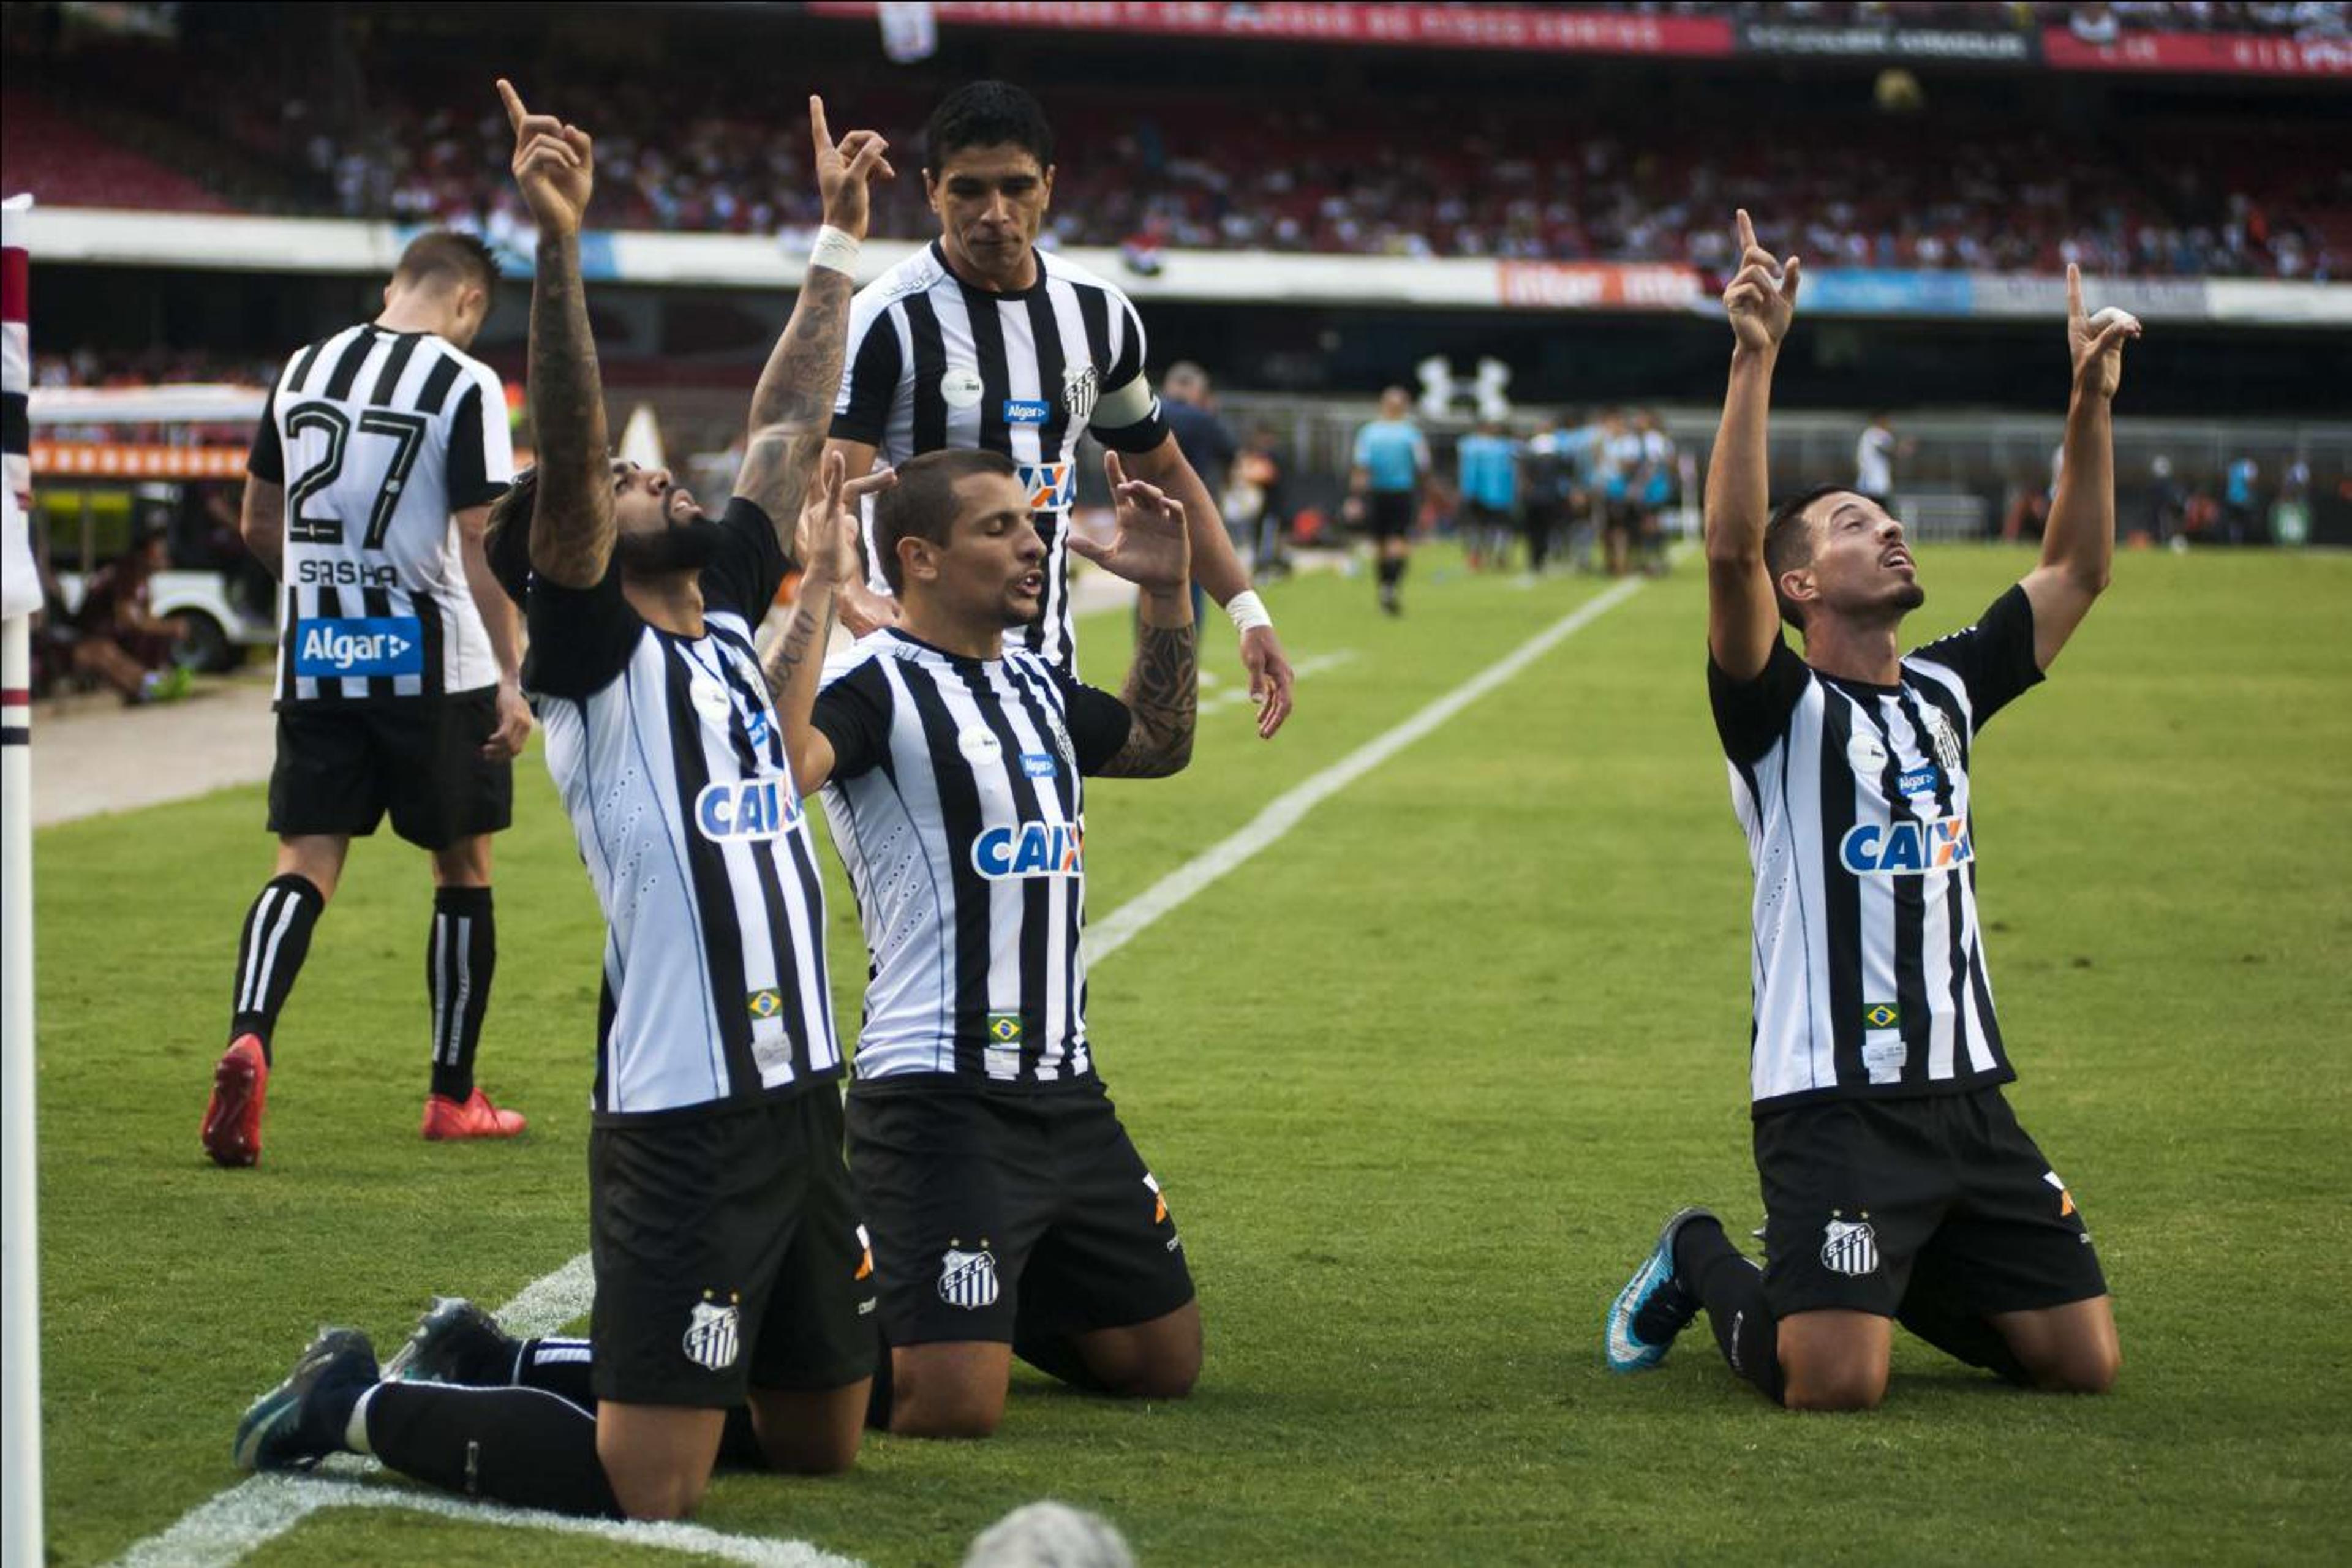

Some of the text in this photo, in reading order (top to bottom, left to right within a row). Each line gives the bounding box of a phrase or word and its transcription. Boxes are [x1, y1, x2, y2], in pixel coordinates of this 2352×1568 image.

[1008, 405, 1038, 421] Algar
[286, 401, 427, 550] 27
[299, 559, 398, 588] SASHA
[303, 627, 383, 669] Algar
[976, 825, 1081, 876] CAIX
